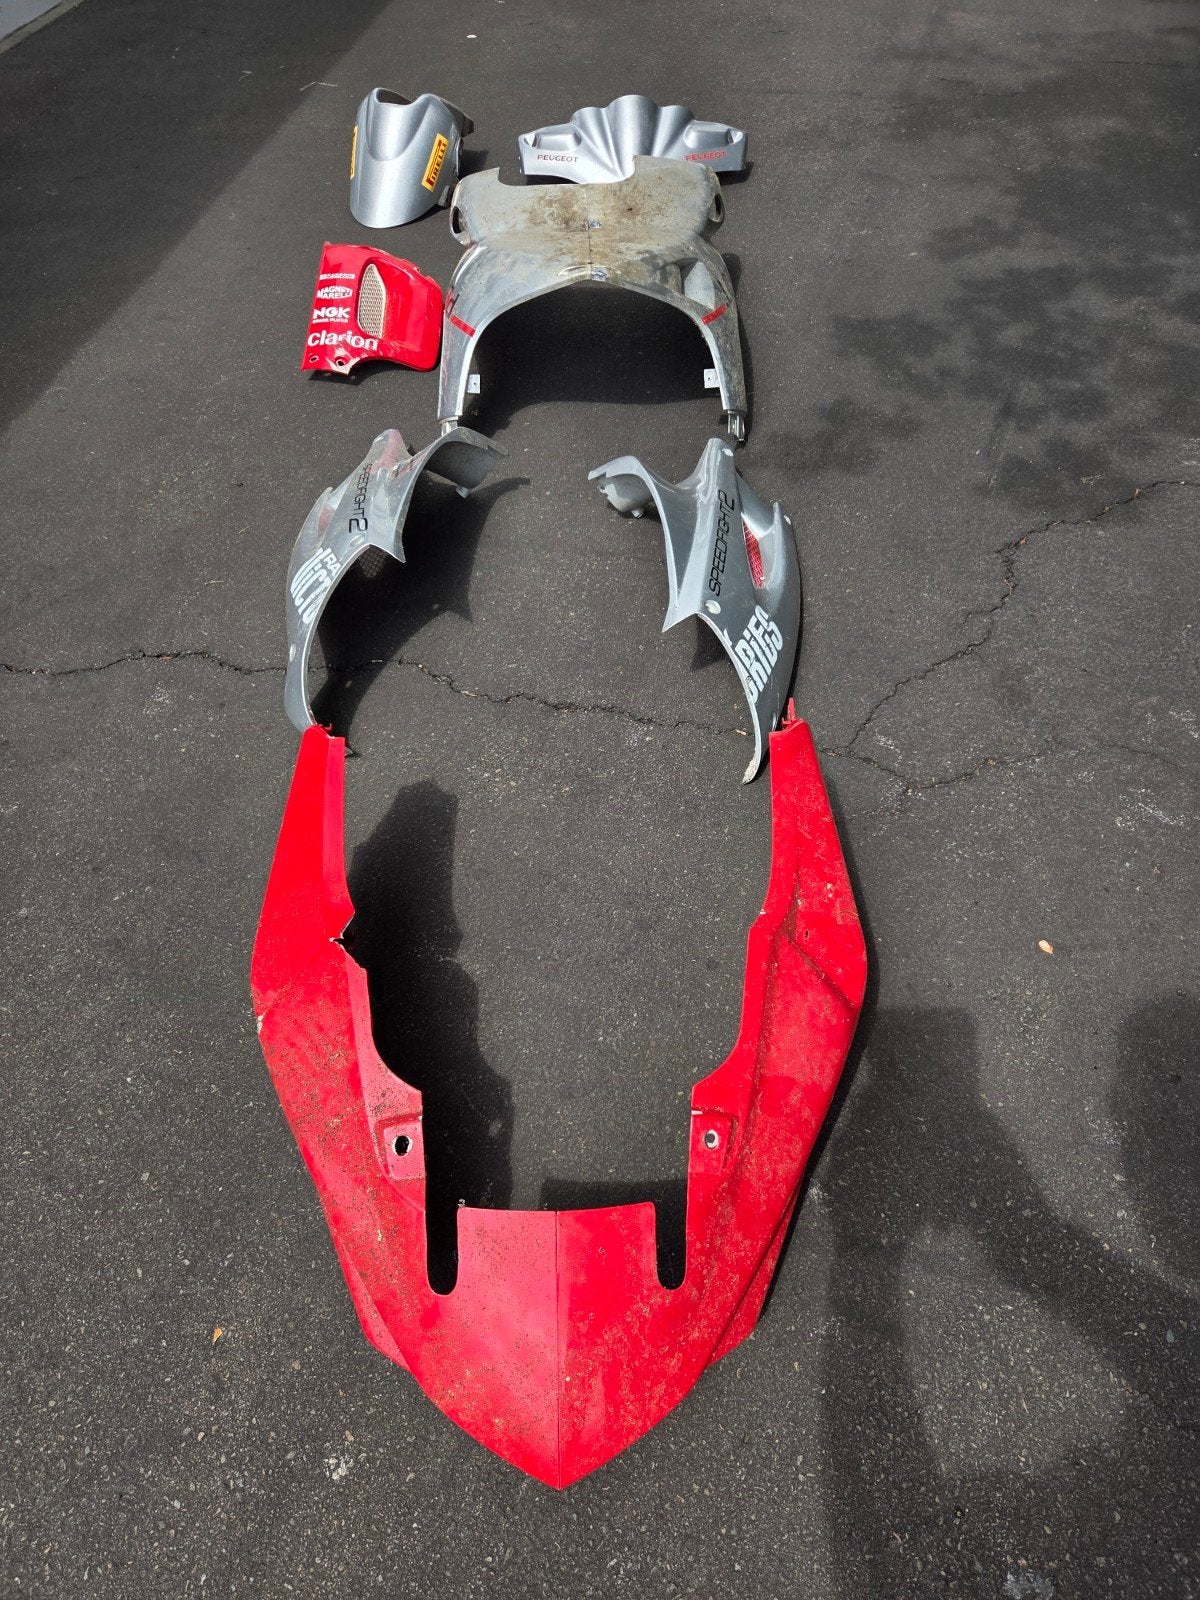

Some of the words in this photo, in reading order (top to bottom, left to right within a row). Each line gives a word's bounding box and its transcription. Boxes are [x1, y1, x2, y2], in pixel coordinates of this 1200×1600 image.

[537, 154, 579, 162] PEUGEOT
[685, 151, 726, 161] PEUGEOT
[426, 139, 447, 187] PIRELLI
[313, 306, 351, 319] NGK
